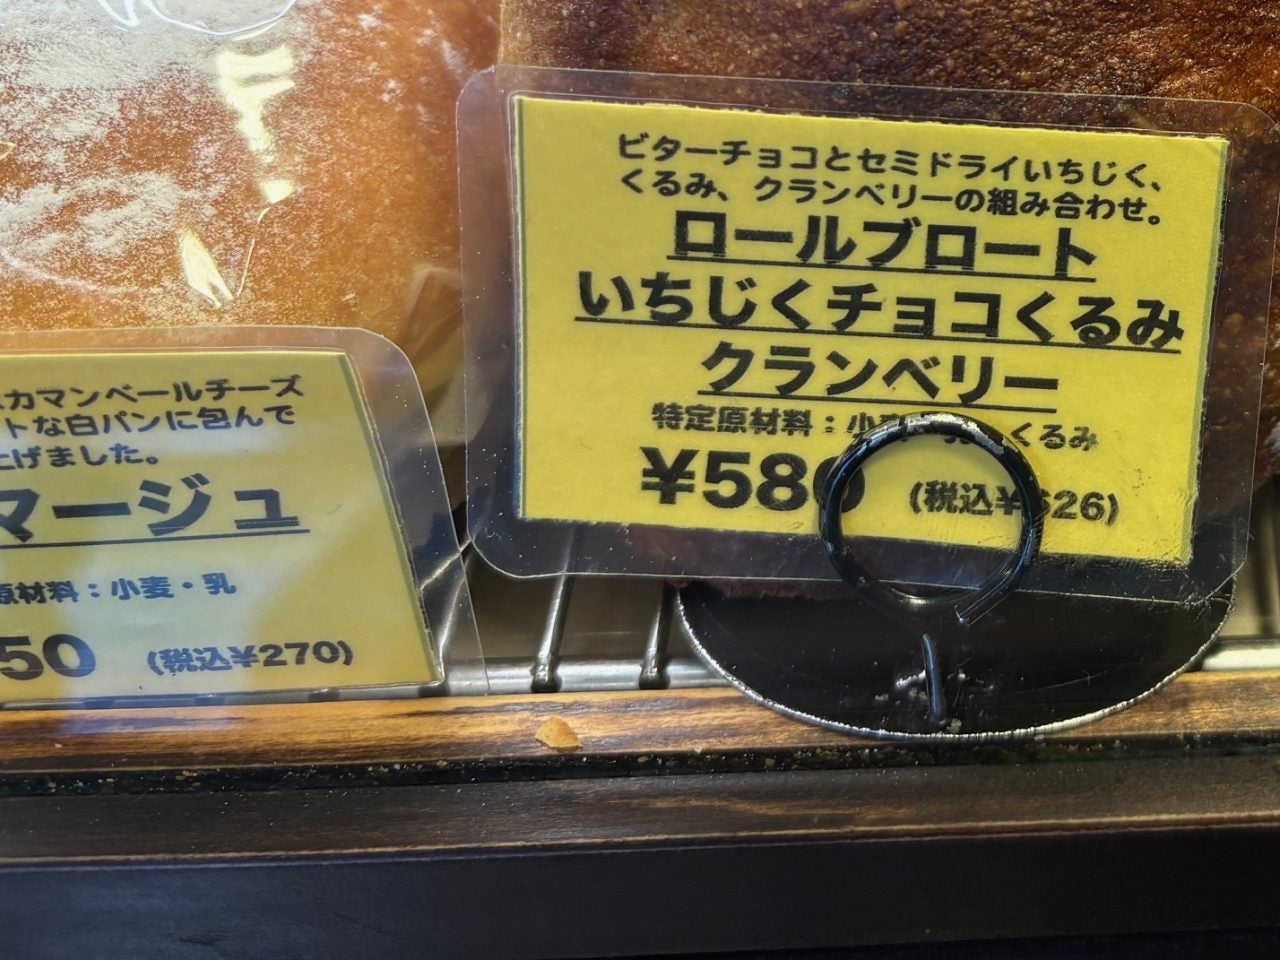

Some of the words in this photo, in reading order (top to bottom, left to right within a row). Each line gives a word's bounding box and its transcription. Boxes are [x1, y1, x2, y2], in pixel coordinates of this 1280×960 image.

[618, 131, 1161, 191] ビターチョコとセミドライいちじく、
[621, 167, 1160, 225] くるみ、クランベリーの組み合わせ。
[674, 210, 1097, 278] ロールブロート
[577, 270, 1184, 349] いちじくチョコくるみ
[0, 375, 304, 411] カマンベールチーズ
[700, 340, 1060, 402] クランベリー
[3, 406, 296, 440] トな白パンに包んで
[652, 402, 1100, 451] 特定原材料：小くるみ
[146, 640, 353, 677] (税込¥270)
